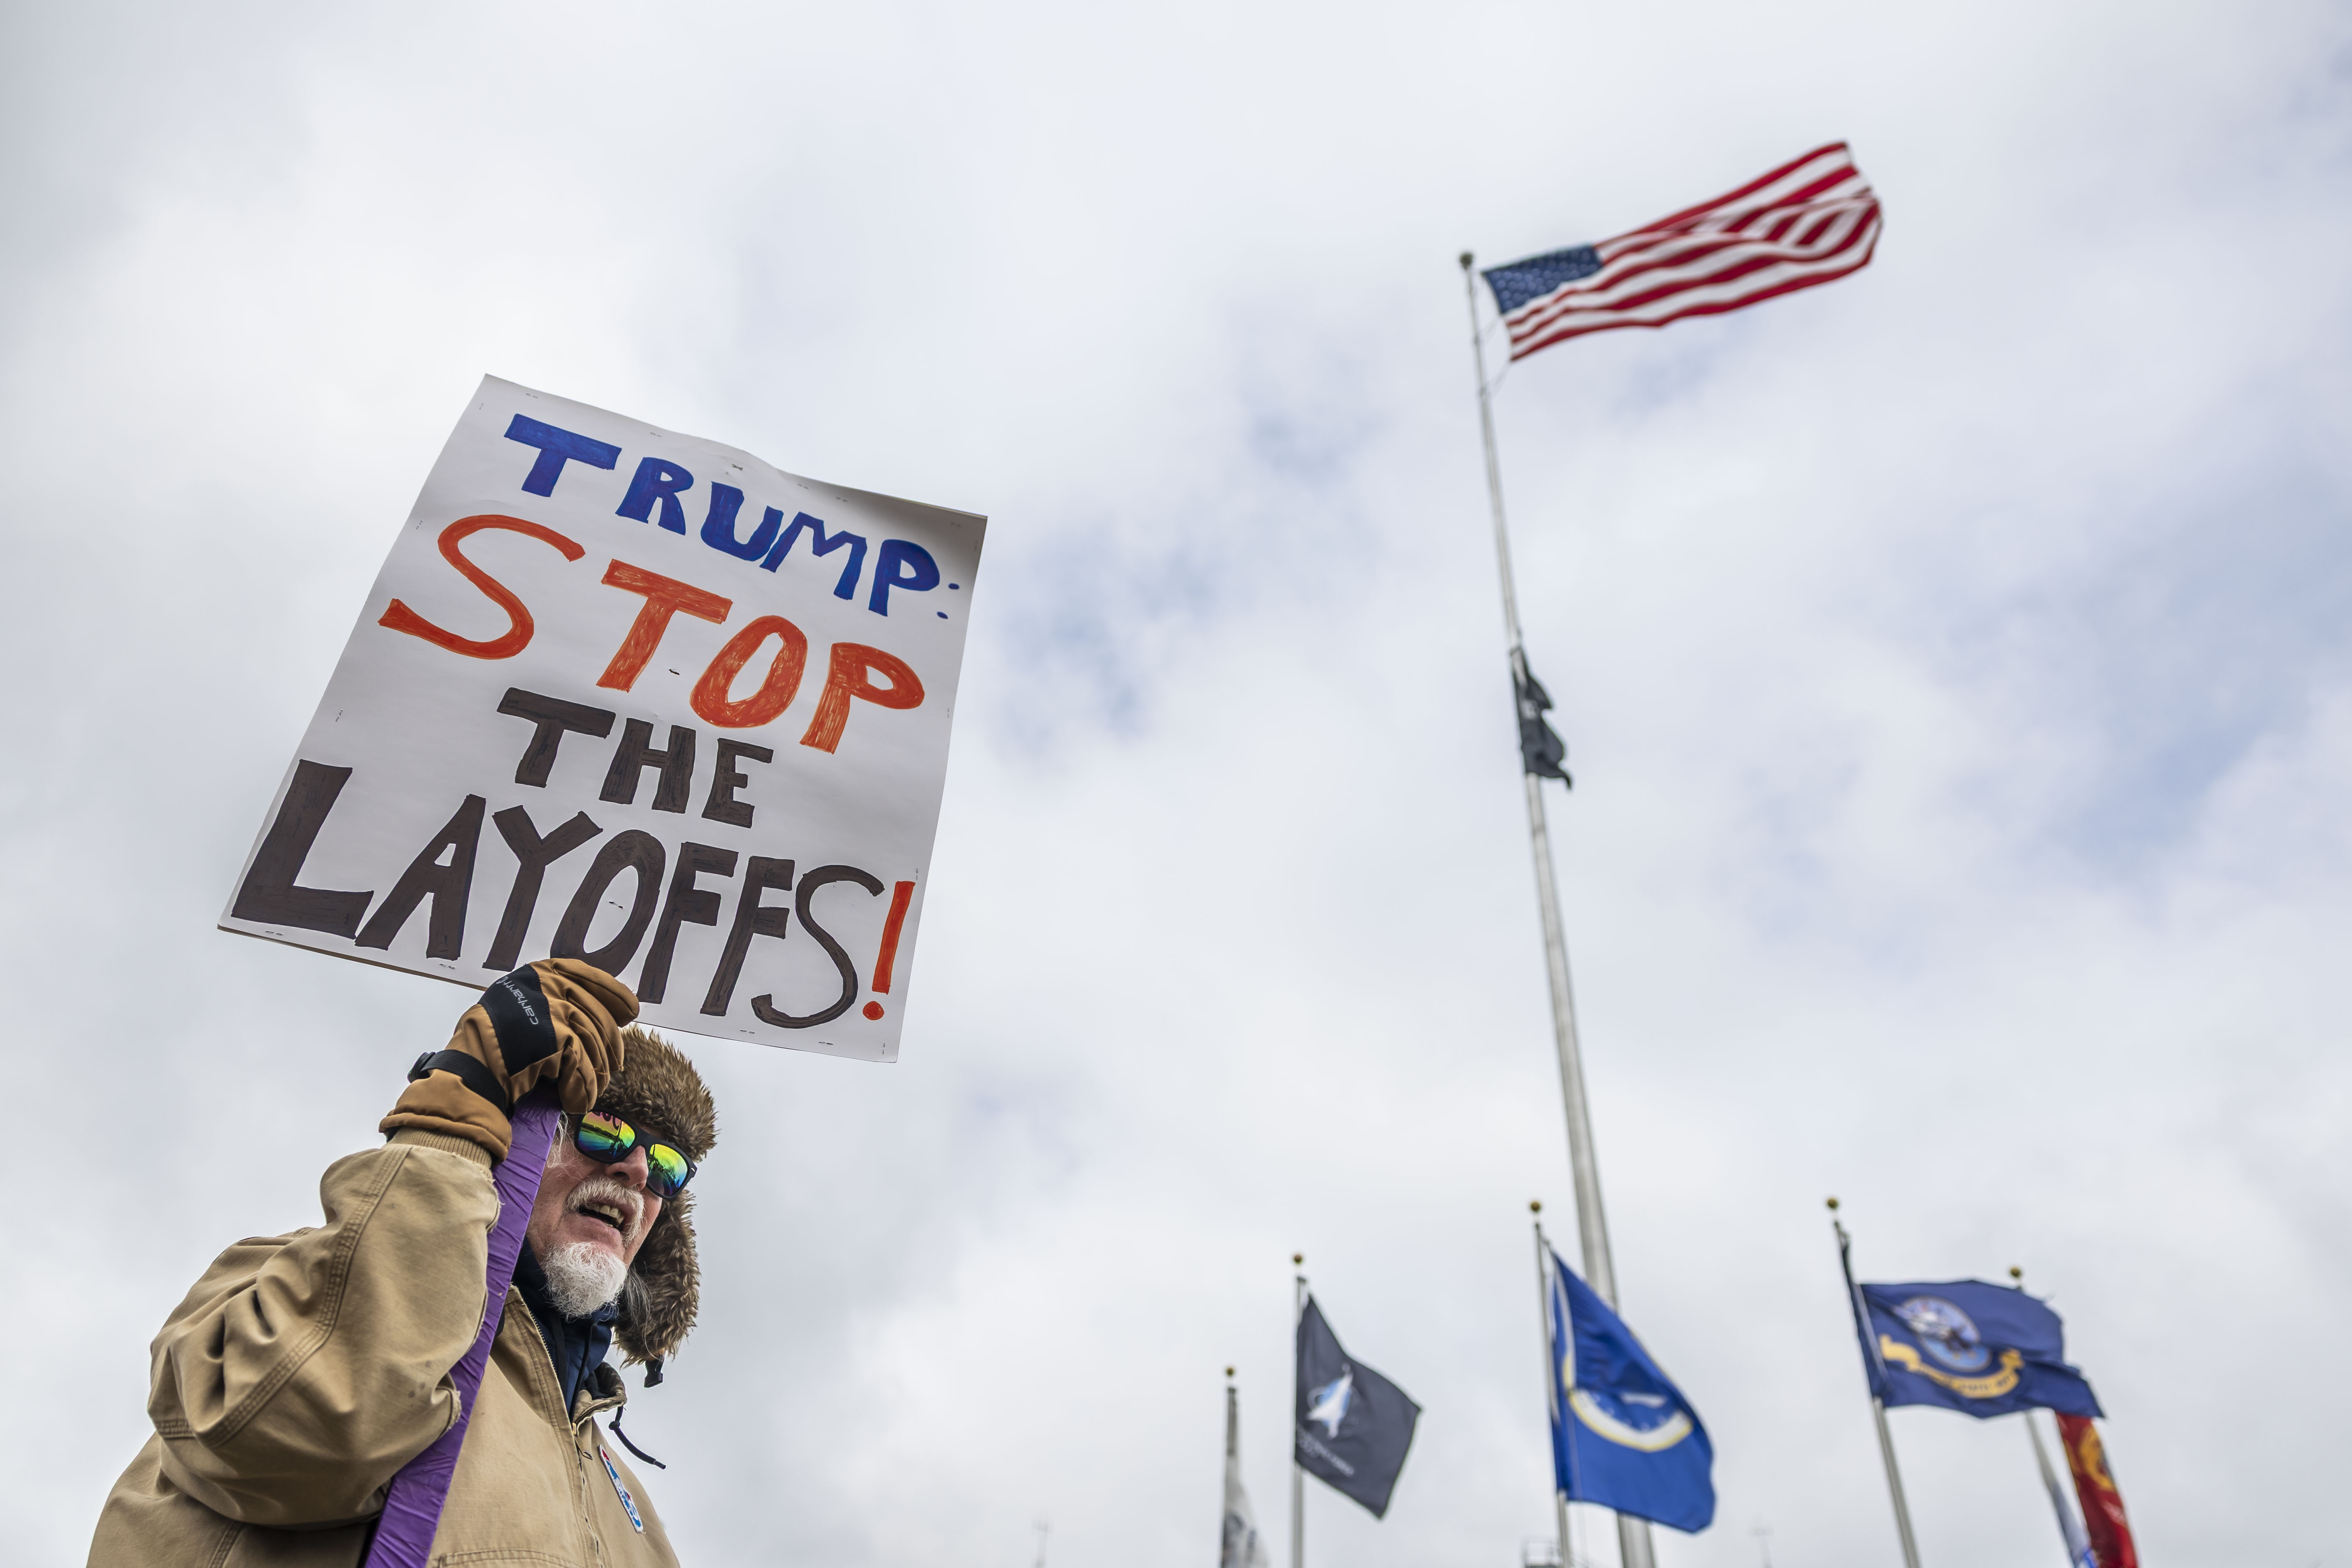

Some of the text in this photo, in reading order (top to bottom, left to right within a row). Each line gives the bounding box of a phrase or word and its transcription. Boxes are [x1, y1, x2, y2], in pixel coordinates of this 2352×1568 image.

[504, 414, 960, 619] TRUMP:
[378, 514, 925, 755] STOP
[497, 687, 774, 828] THE
[231, 759, 916, 1029] LAYOFFS!
[503, 980, 539, 1025] carhartt
